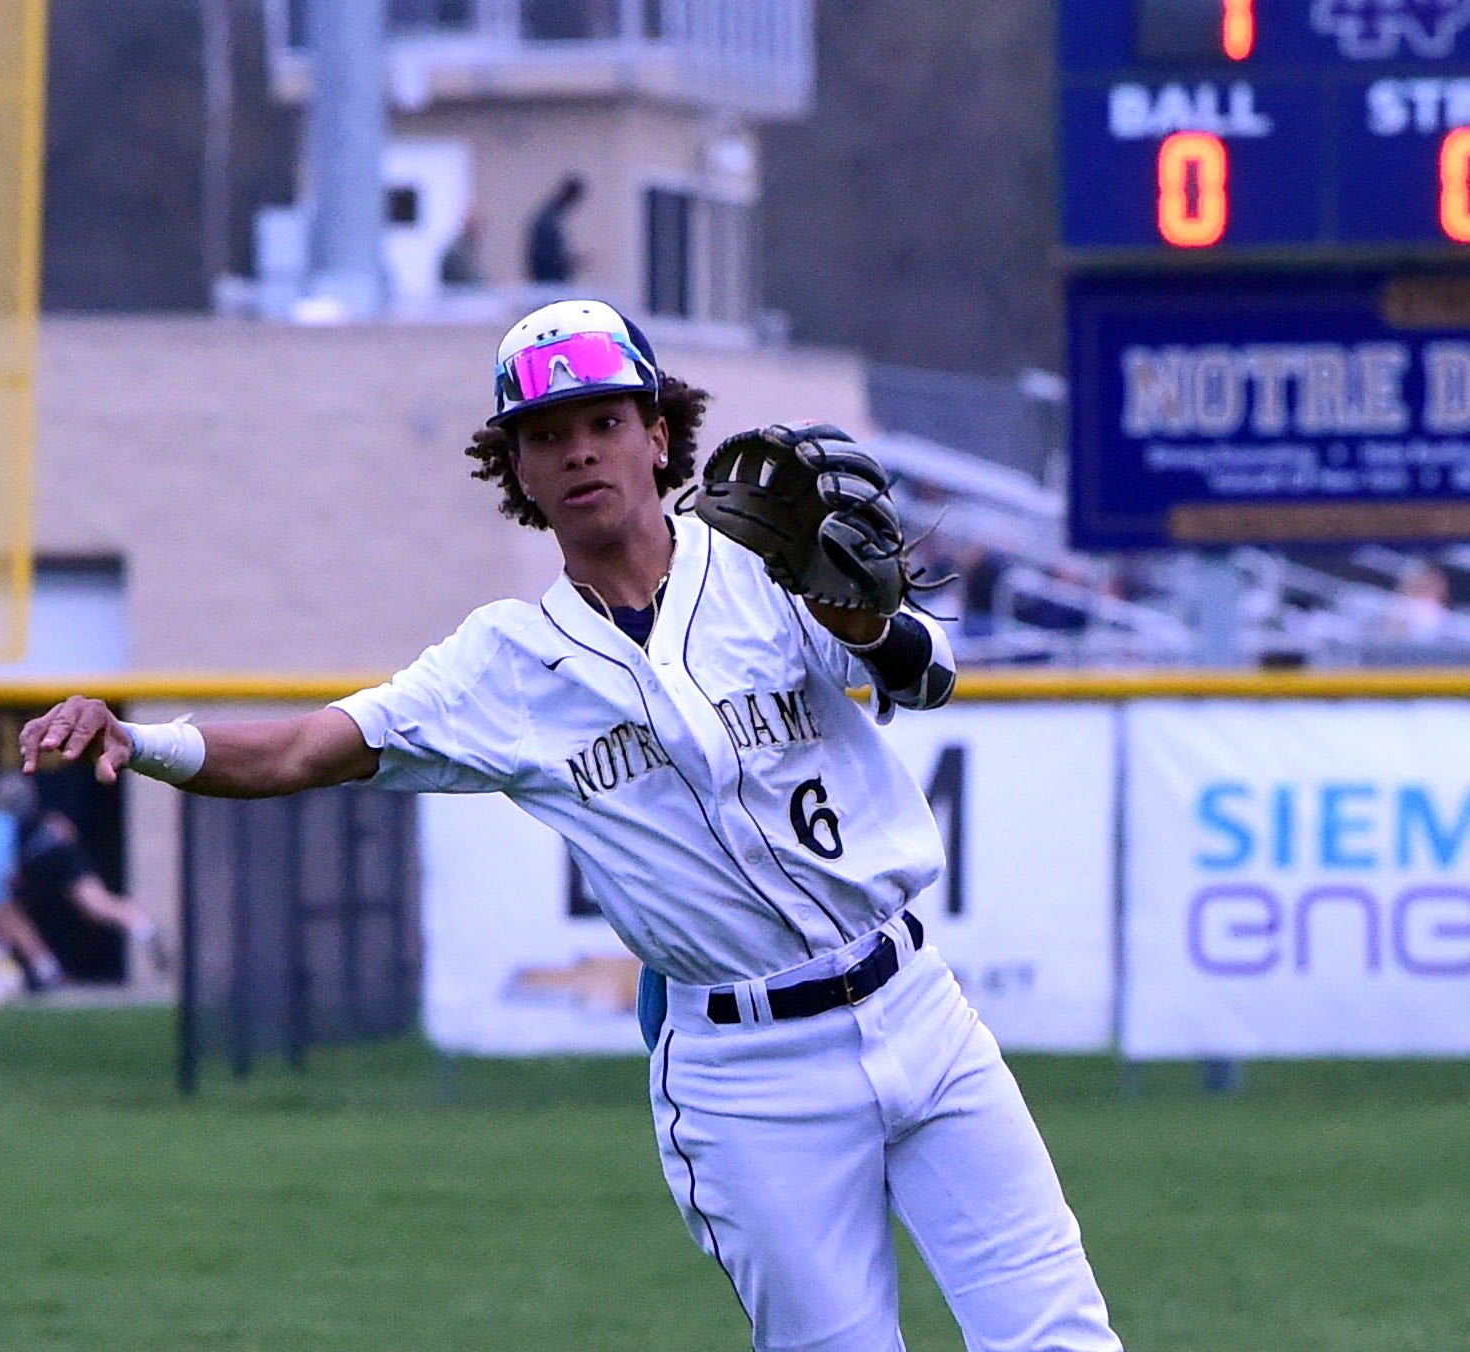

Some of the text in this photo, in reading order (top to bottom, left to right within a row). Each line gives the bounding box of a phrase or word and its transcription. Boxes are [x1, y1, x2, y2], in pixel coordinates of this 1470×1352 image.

[1110, 82, 1274, 139] BALL
[1157, 131, 1227, 247] 0
[1122, 343, 1410, 438] NOTRE
[790, 773, 843, 859] 6
[1194, 781, 1470, 870] SIEM
